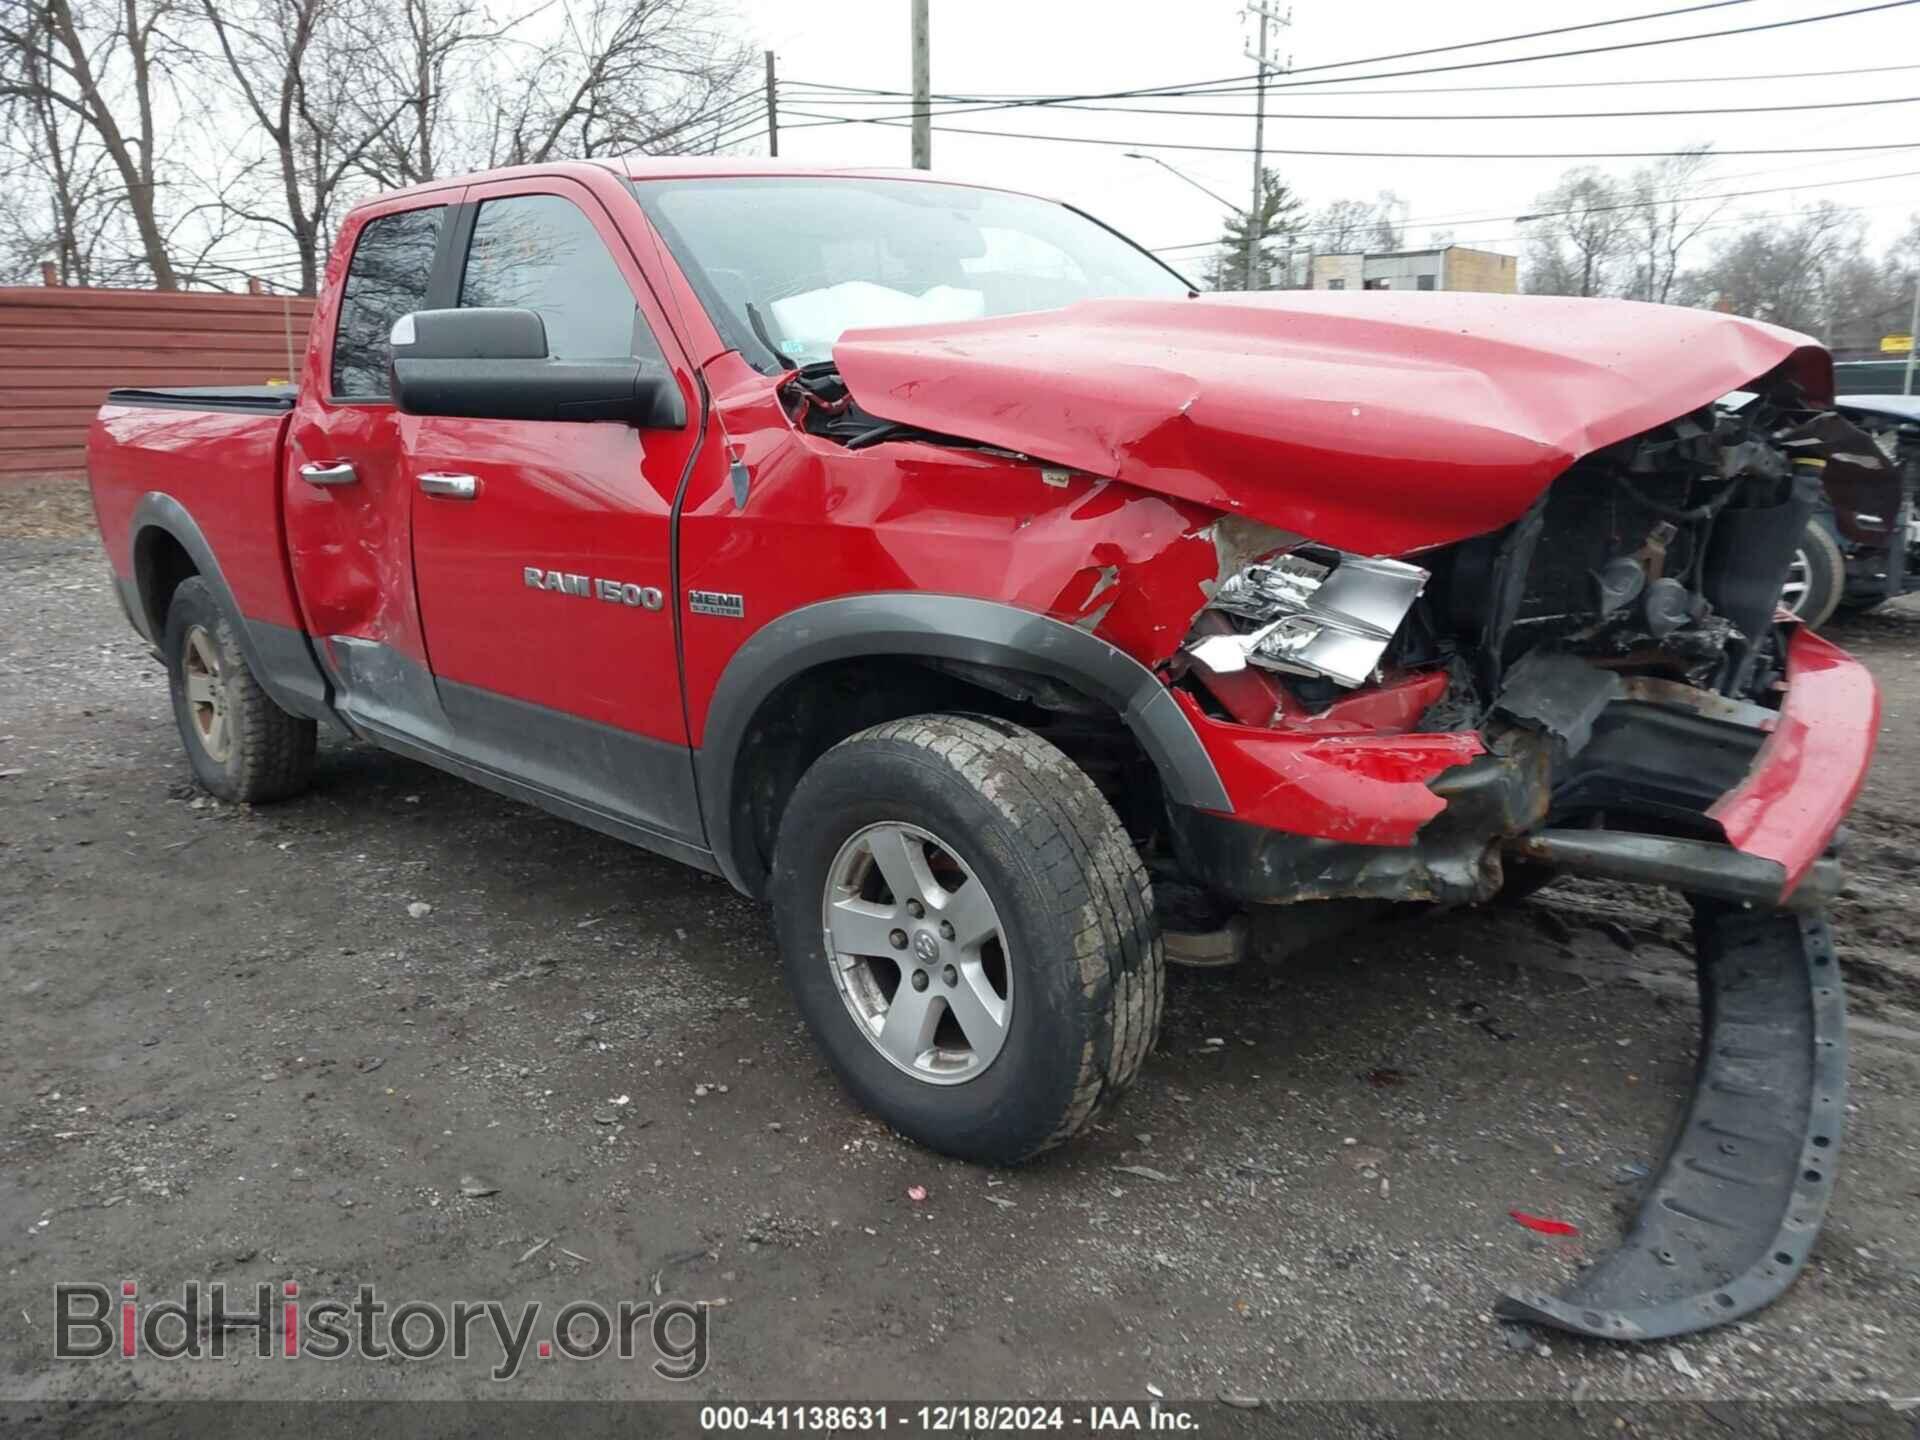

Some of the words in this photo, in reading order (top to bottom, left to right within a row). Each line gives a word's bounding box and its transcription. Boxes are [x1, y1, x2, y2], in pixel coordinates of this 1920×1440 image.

[523, 566, 592, 598] RAM
[595, 578, 664, 612] 1500
[689, 591, 742, 608] HEMI
